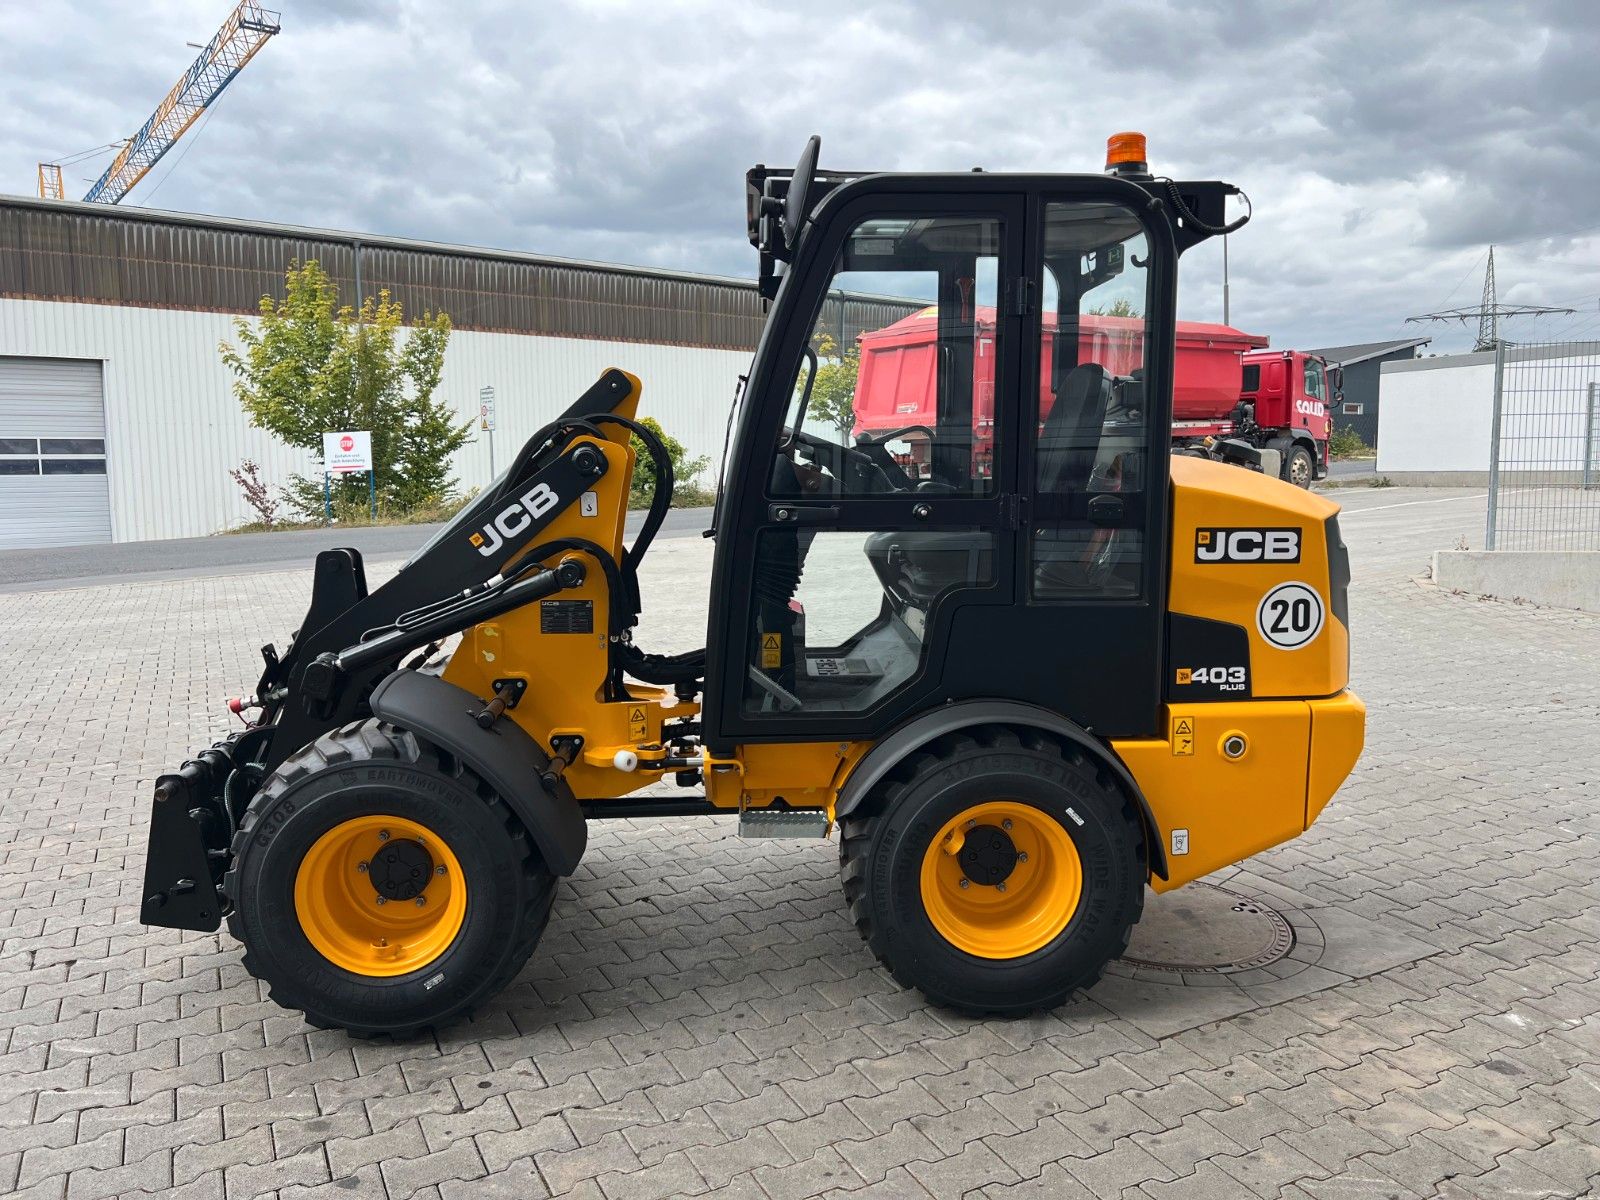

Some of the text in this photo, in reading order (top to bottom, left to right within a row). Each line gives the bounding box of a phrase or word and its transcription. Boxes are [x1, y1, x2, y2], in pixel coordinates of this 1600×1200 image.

[478, 482, 560, 557] JCB
[1197, 531, 1299, 560] JCB
[1270, 598, 1311, 634] 20
[1191, 667, 1246, 684] 403
[1219, 683, 1246, 691] PLUS
[254, 799, 297, 848] G308
